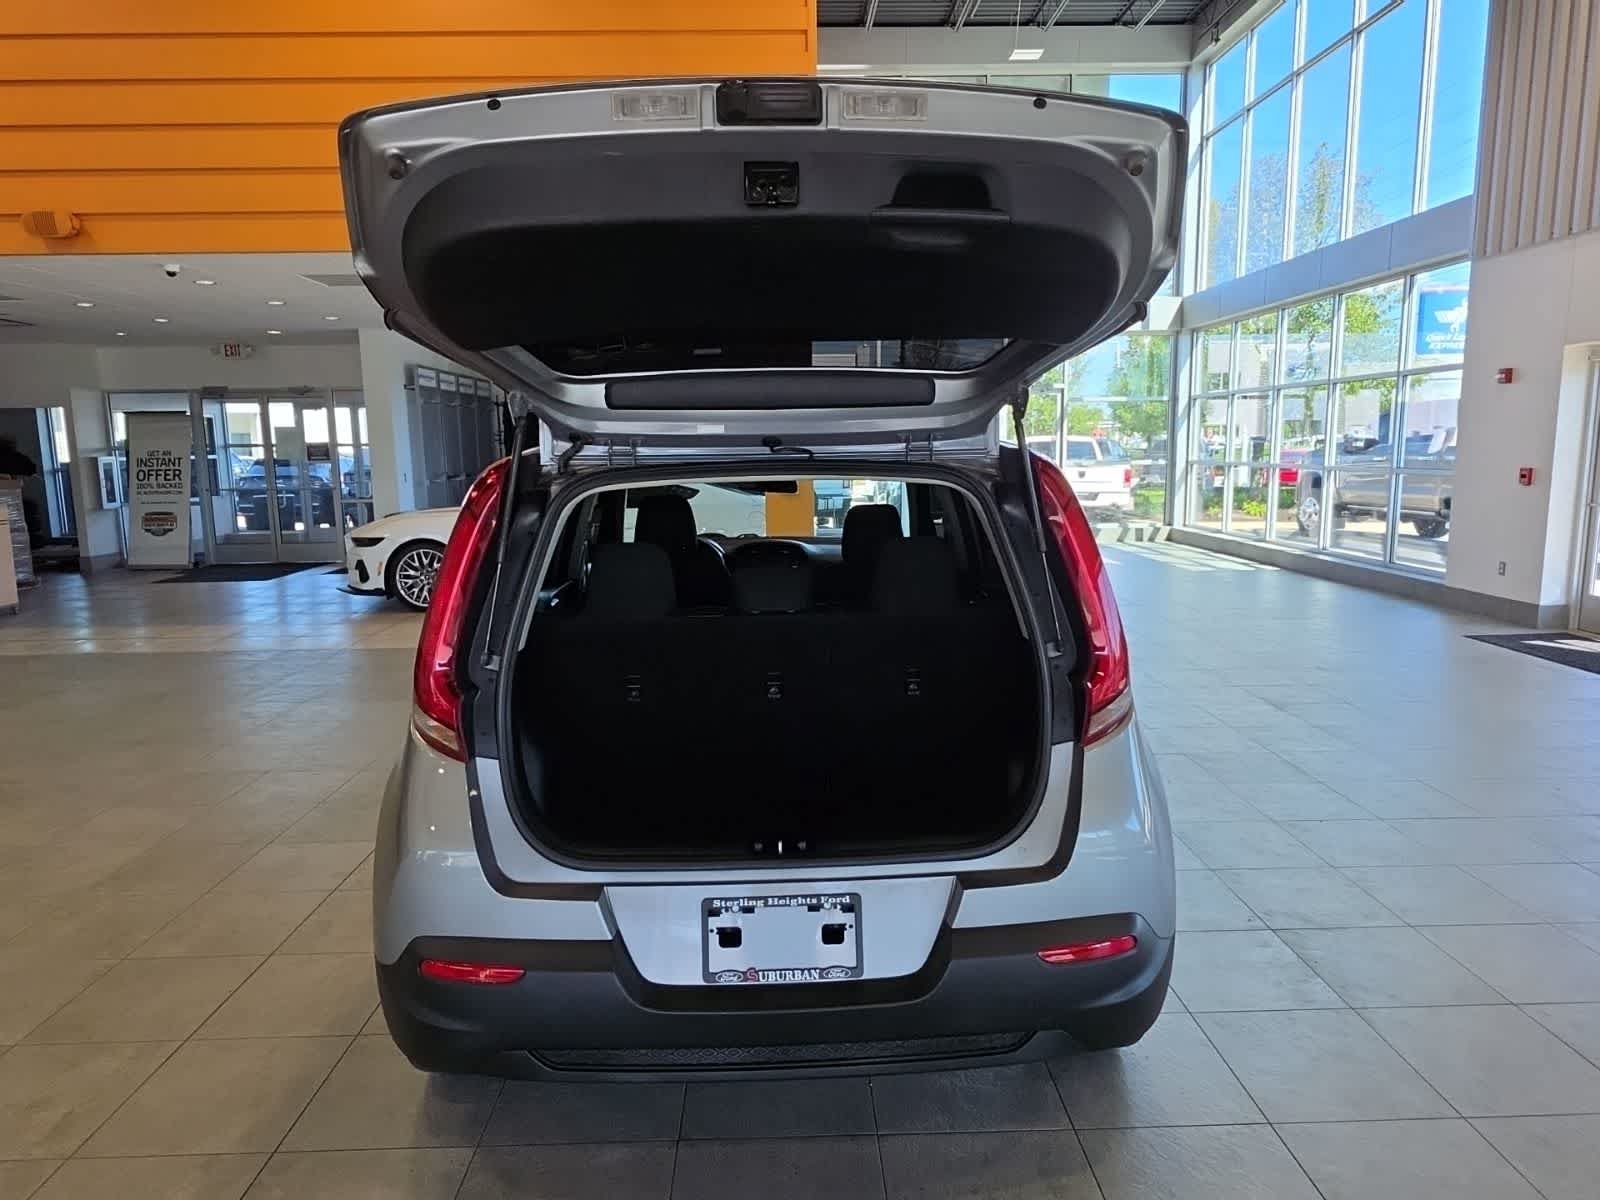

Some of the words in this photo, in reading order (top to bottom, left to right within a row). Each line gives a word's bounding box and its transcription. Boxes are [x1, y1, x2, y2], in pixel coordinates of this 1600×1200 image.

[224, 343, 241, 357] EXIT
[136, 457, 183, 468] INSTANT
[136, 469, 182, 482] OFFER
[136, 482, 154, 490] 100%
[156, 482, 183, 490] BACKED
[712, 898, 765, 908] Sterling
[767, 896, 817, 906] Heights
[820, 895, 850, 905] Ford
[746, 967, 820, 984] SUBURBAN
